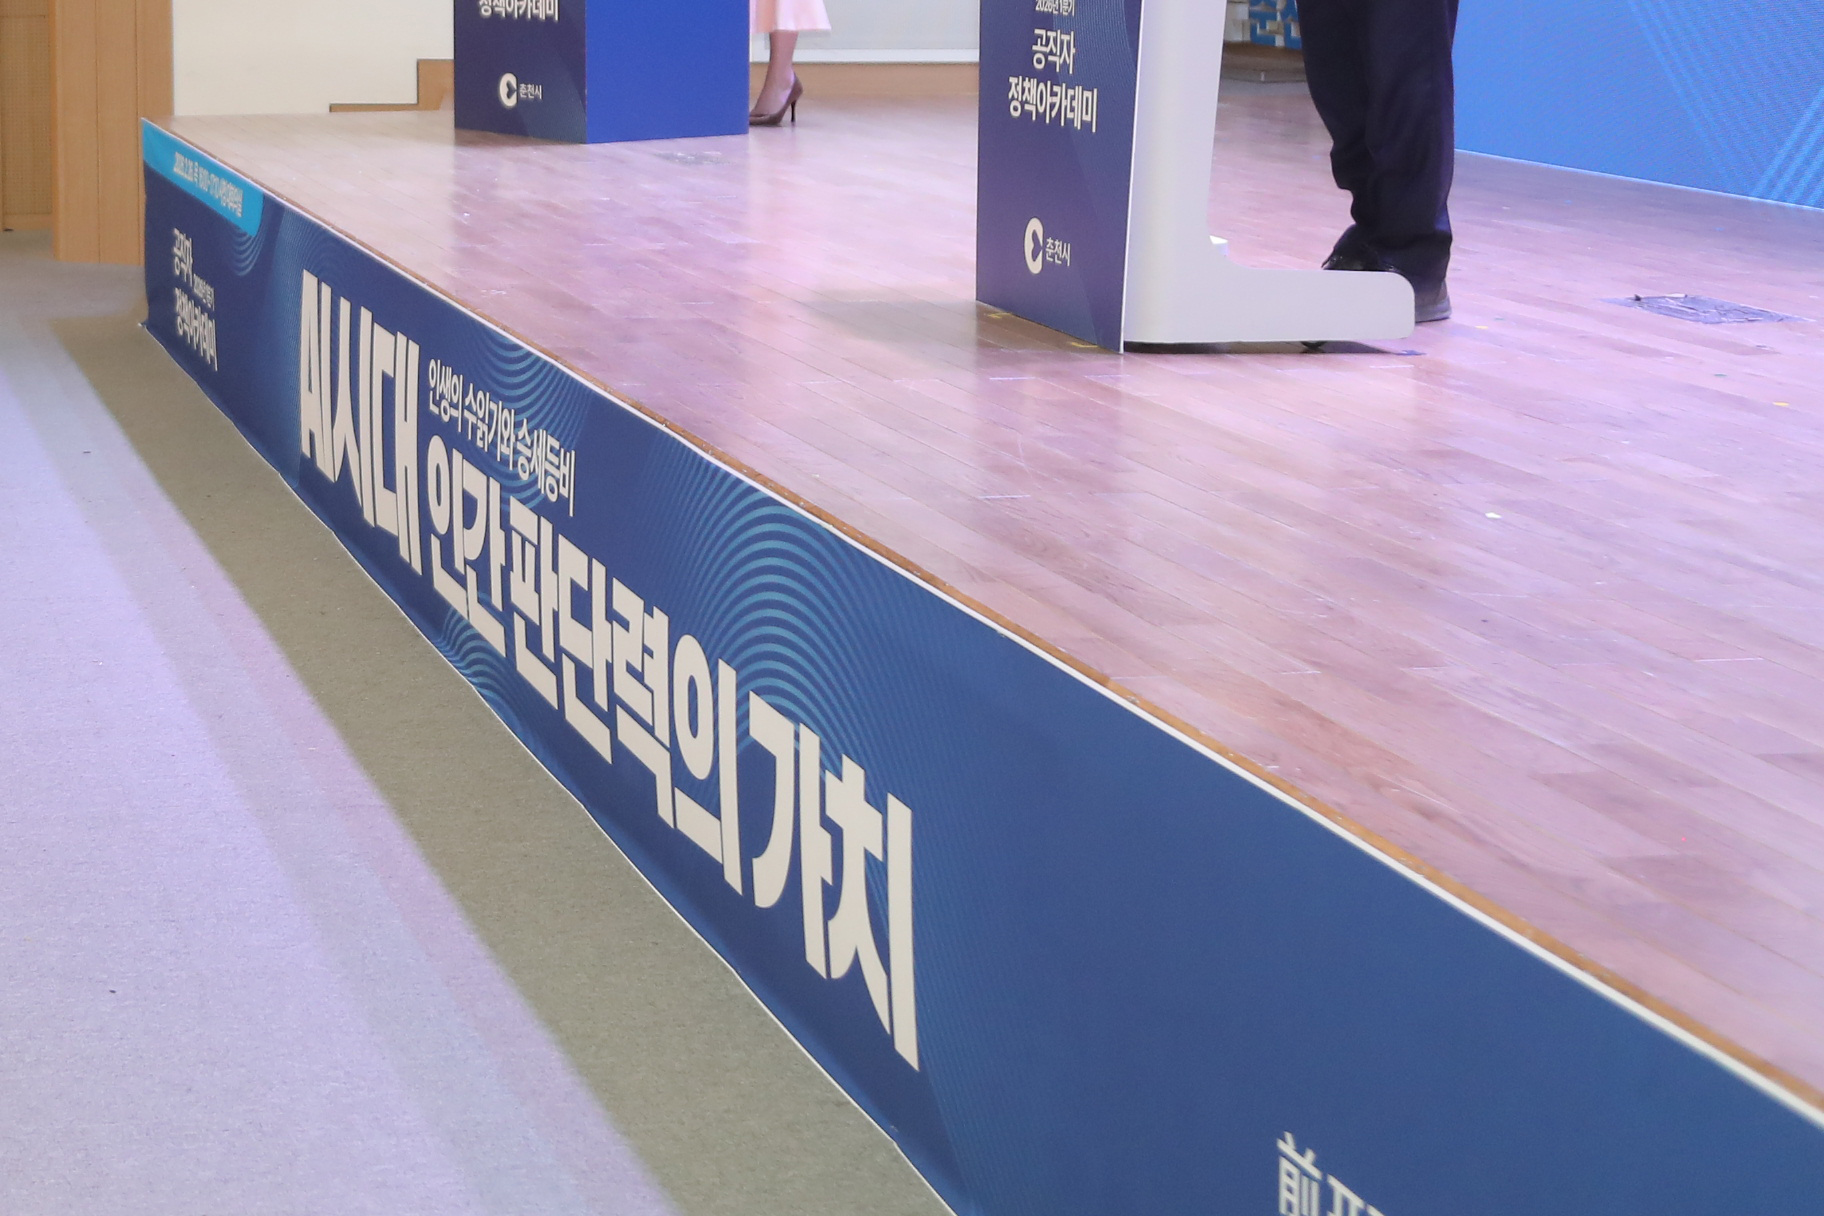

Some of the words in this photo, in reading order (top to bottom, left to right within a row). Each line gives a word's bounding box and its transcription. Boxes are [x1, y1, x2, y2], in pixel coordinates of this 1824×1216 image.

[1032, 28, 1076, 75] 공직자
[519, 83, 543, 100] 춘천시
[1008, 75, 1098, 133] 정책아카데미
[1045, 237, 1072, 266] 춘천시
[429, 359, 463, 432] 인생의
[464, 382, 516, 471] 수읽기와
[517, 417, 576, 517] 승세등비
[300, 268, 422, 576] AI시대
[426, 434, 505, 657] 인간
[509, 495, 744, 896] 판단력의
[749, 690, 920, 1072] 가치
